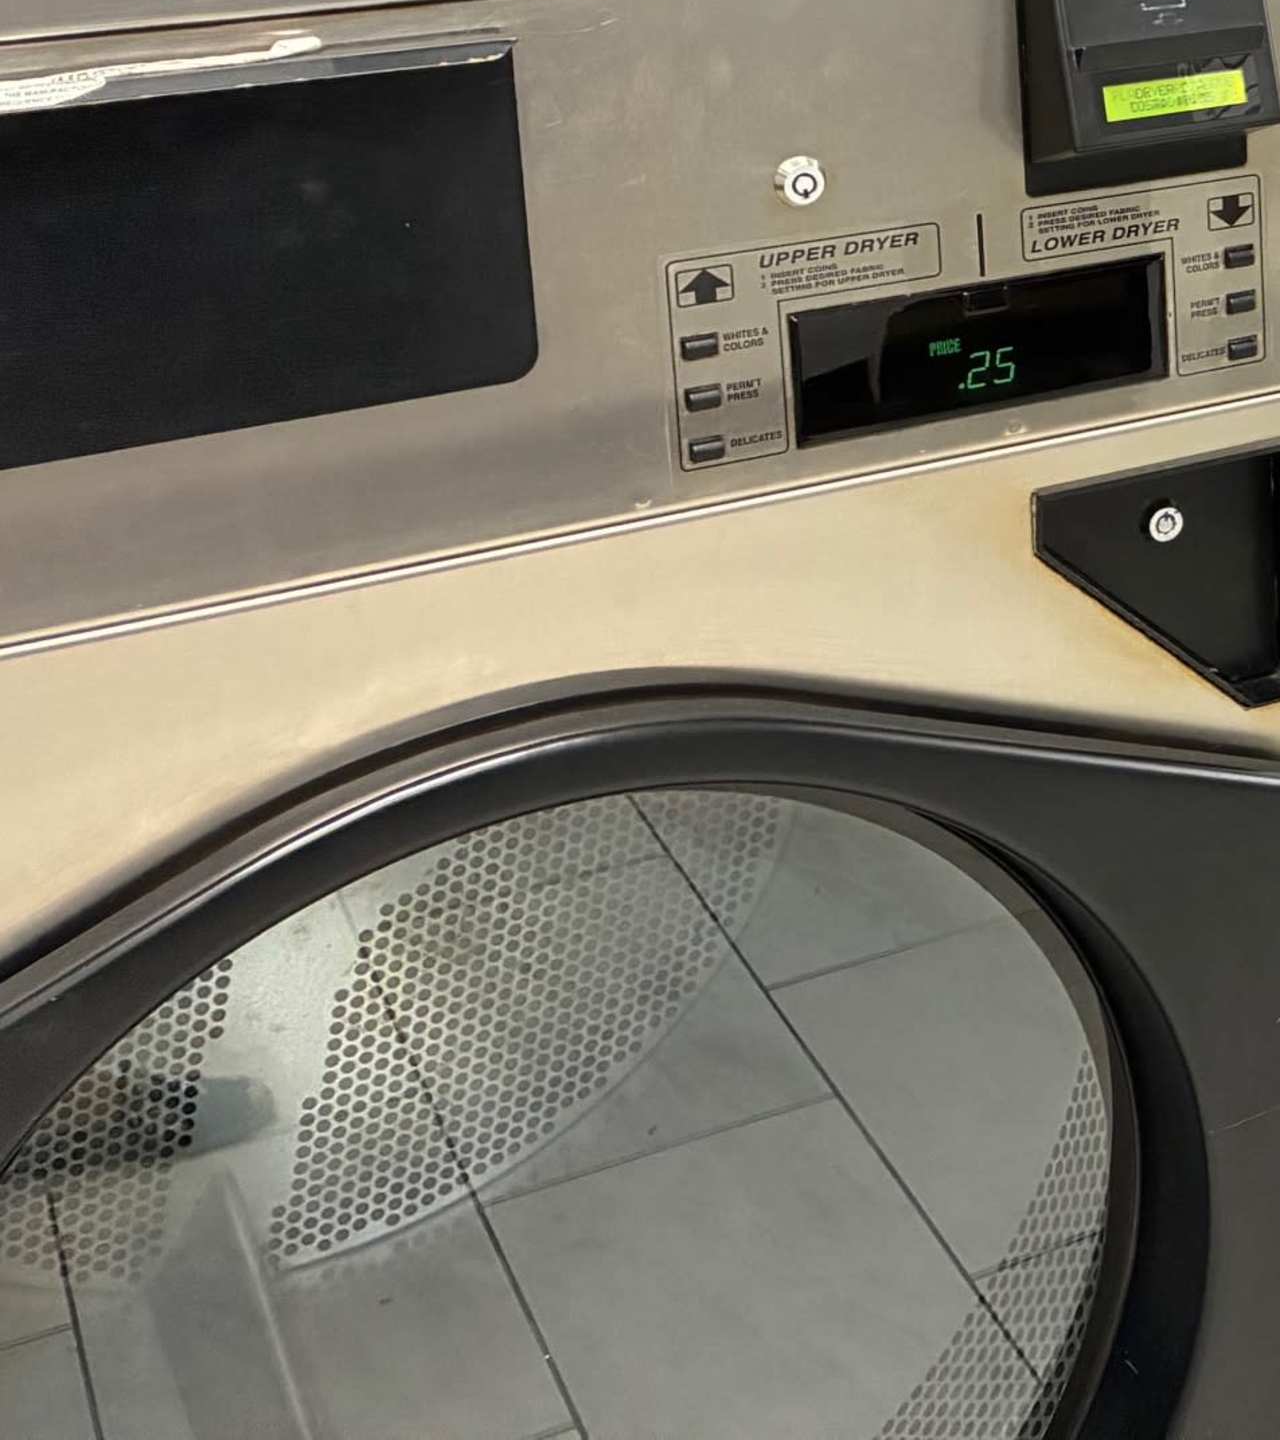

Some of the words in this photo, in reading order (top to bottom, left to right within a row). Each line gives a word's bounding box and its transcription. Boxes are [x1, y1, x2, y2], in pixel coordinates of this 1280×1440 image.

[1037, 209, 1069, 219] INSERT
[1031, 229, 1106, 254] LOWER
[1112, 218, 1181, 241] DRYER
[759, 245, 837, 269] UPPER
[844, 232, 920, 256] DRYER
[770, 267, 807, 279] INSERT
[814, 279, 836, 290] FOR
[723, 328, 760, 341] WHITES
[723, 337, 765, 351] COLORS
[928, 338, 963, 357] PRICE
[958, 346, 1016, 390] .25
[726, 378, 762, 391] PERM'T
[727, 389, 760, 402] PRESS
[730, 430, 784, 447] DELICATES
